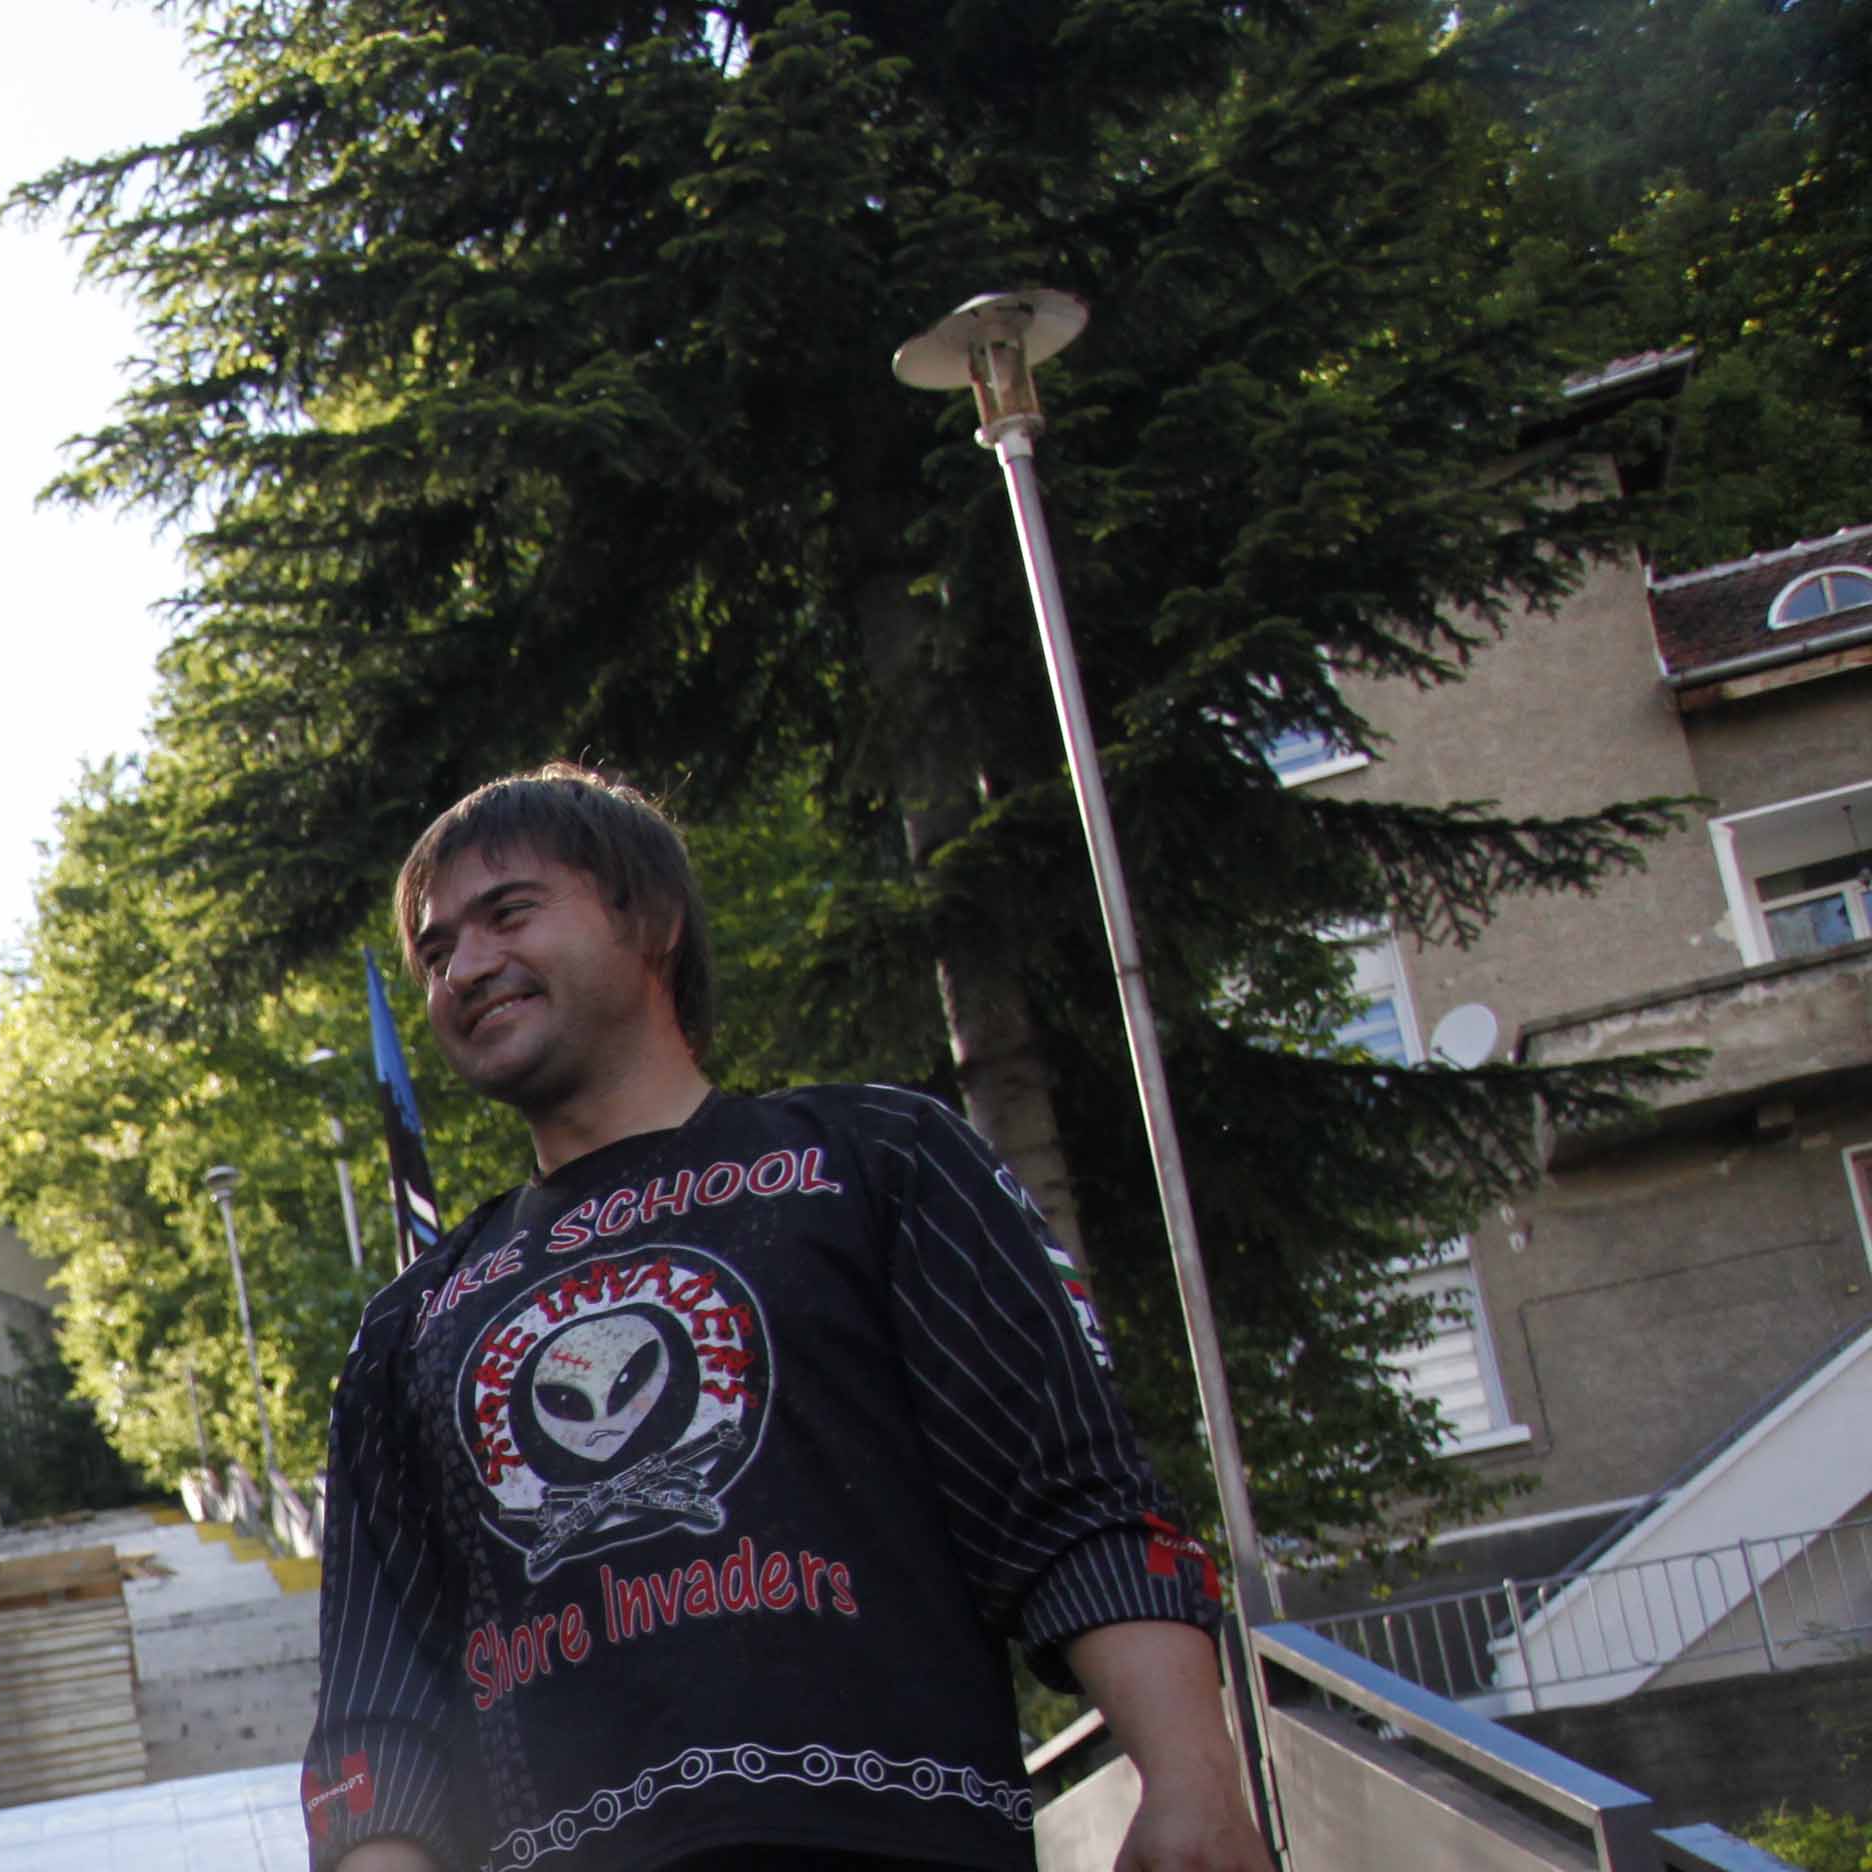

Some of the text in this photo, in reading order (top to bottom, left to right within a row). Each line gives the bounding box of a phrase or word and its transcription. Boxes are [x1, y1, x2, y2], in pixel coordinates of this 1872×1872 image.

[547, 1147, 842, 1252] SCHOOL
[465, 1535, 858, 1712] Shore Invaders
